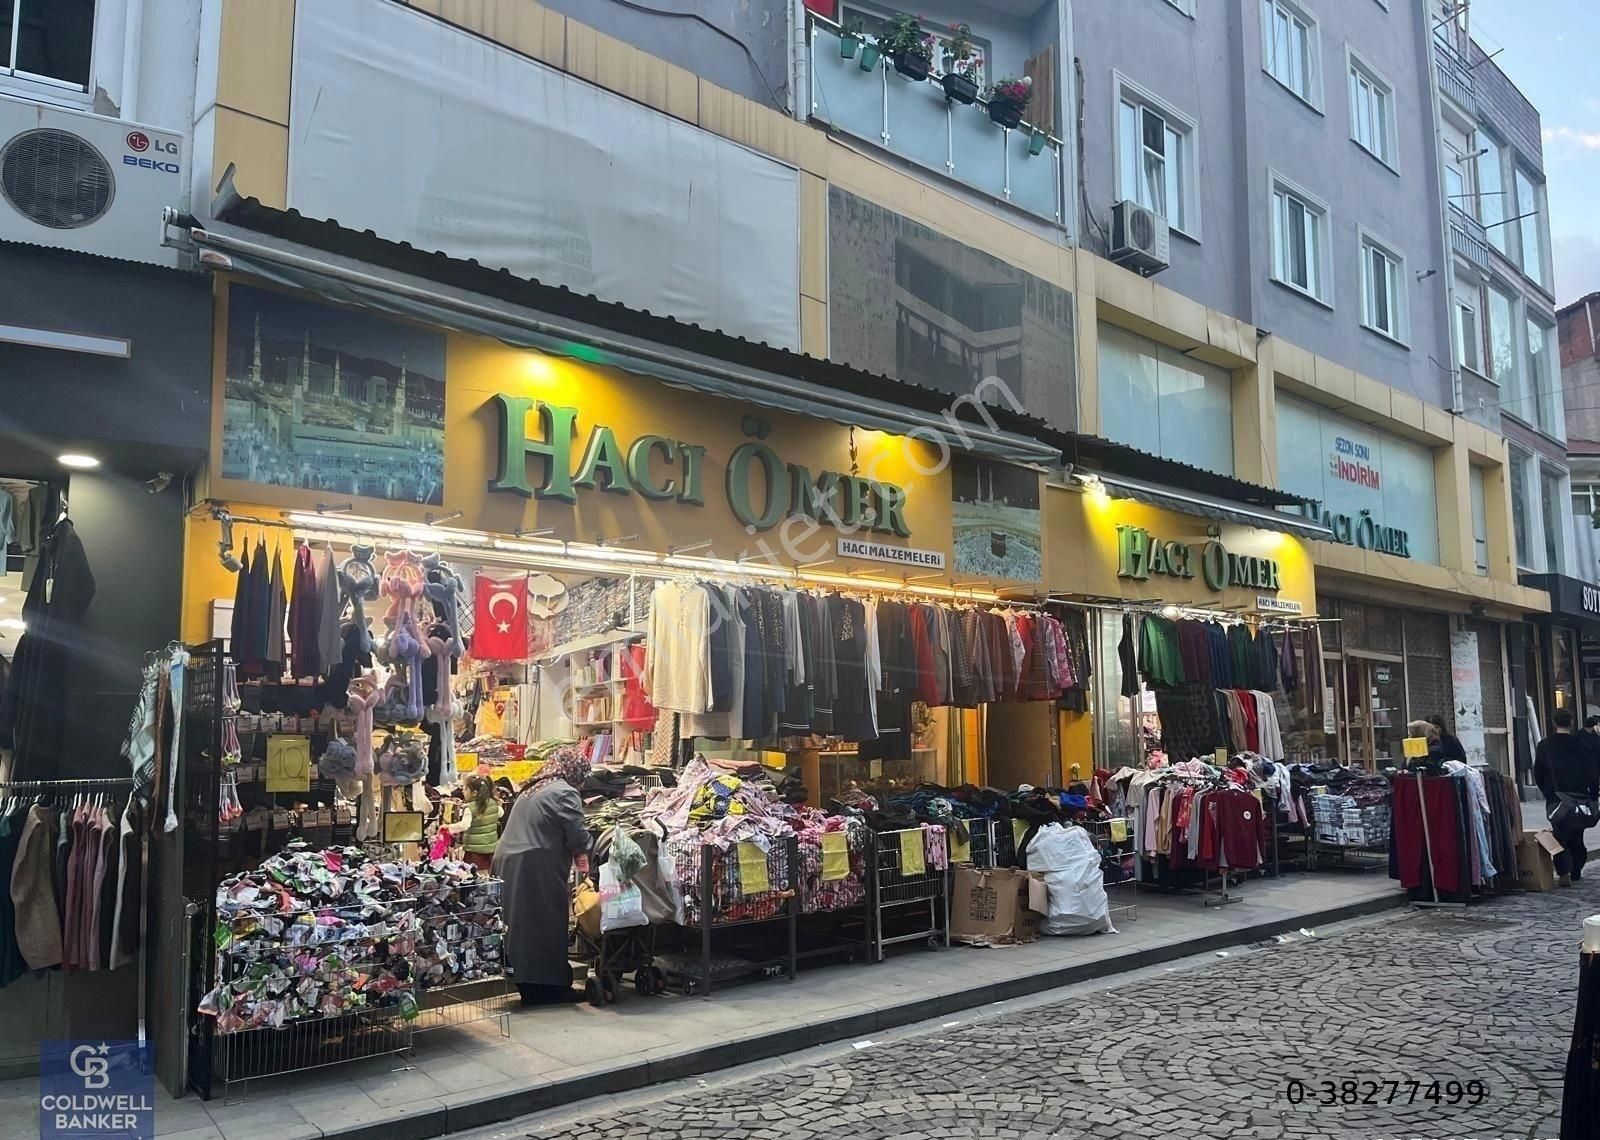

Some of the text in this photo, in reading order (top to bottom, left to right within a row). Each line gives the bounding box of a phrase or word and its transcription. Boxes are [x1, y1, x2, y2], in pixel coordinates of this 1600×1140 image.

[154, 139, 178, 155] LG
[123, 155, 180, 174] BEKO
[1335, 437, 1370, 461] SEZON SONU
[488, 392, 911, 537] HACI ÖMER
[1356, 508, 1411, 558] ÖMER
[842, 541, 868, 555] HACI
[1116, 523, 1282, 592] HACI ÖMER
[273, 746, 304, 778] 10
